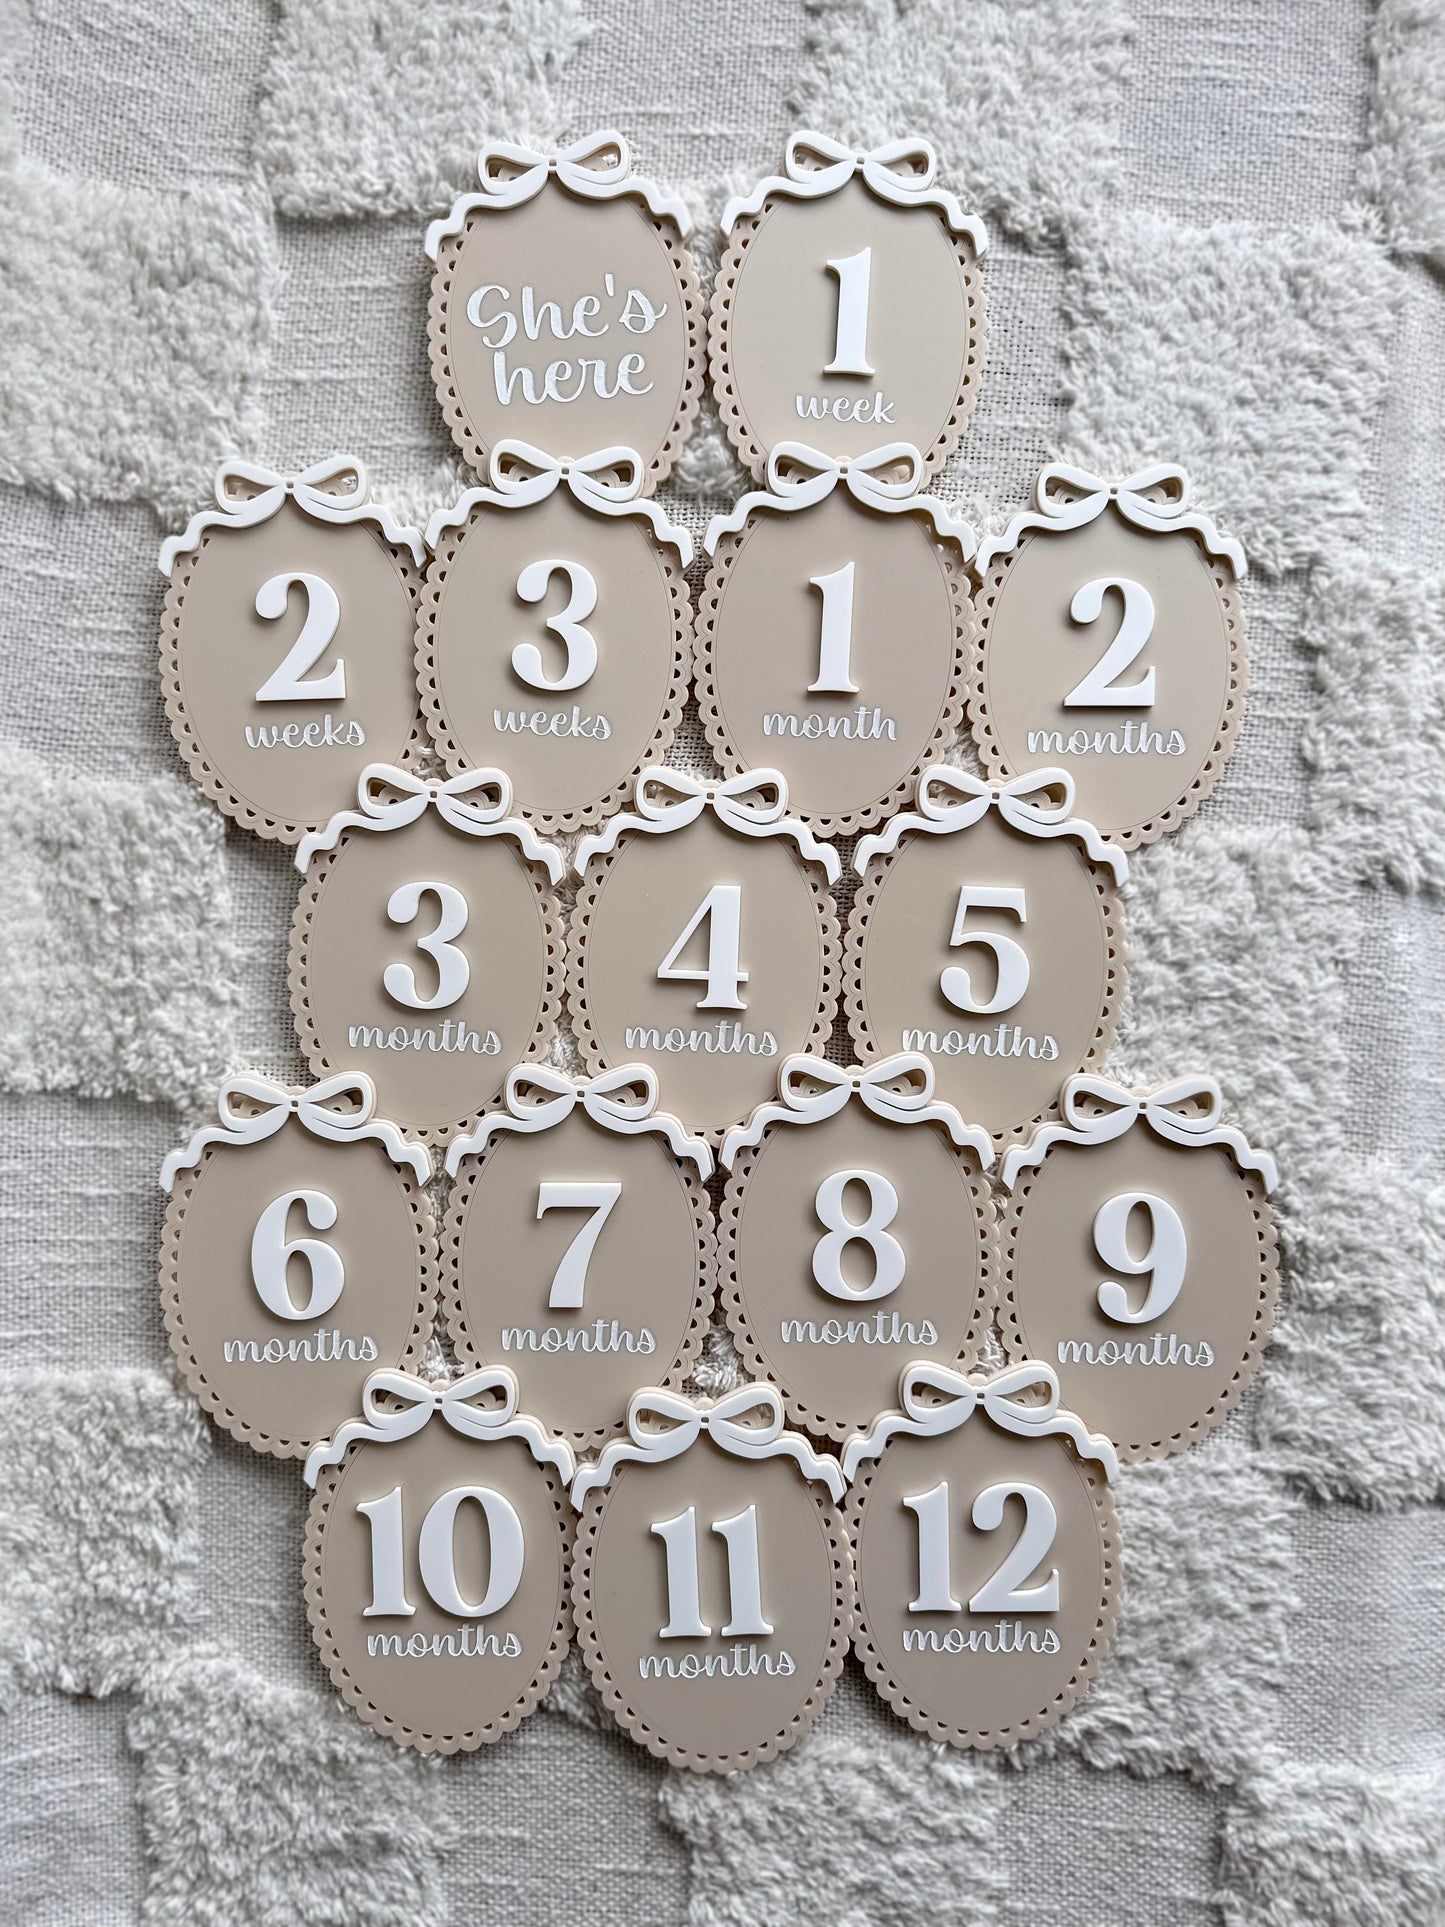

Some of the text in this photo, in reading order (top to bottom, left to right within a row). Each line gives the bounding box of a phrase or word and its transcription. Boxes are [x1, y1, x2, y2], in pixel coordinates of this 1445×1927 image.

[466, 273, 668, 348] She's
[825, 246, 876, 376] 1
[491, 350, 655, 406] here
[795, 391, 897, 425] week
[255, 571, 346, 701] 2
[512, 558, 600, 691] 3
[807, 560, 862, 693] 1
[1064, 576, 1157, 707] 2
[245, 714, 366, 748] weeks
[493, 705, 611, 740] weeks
[763, 706, 897, 741] month
[1027, 720, 1186, 756] months
[384, 881, 470, 1010] 3
[657, 884, 749, 1010] 4
[940, 885, 1031, 1014] 5
[348, 1019, 501, 1056] months
[625, 1020, 778, 1057] months
[901, 1024, 1059, 1061] months
[251, 1189, 345, 1320] 6
[536, 1181, 622, 1309] 7
[812, 1168, 906, 1301] 8
[1095, 1191, 1188, 1324] 9
[224, 1329, 378, 1363] months
[501, 1319, 655, 1354] months
[781, 1310, 938, 1346] months
[1057, 1333, 1214, 1367] months
[356, 1485, 525, 1617] 10
[650, 1504, 774, 1638] 11
[903, 1481, 1060, 1612] 12
[367, 1624, 522, 1659] months
[639, 1646, 796, 1680] months
[903, 1619, 1061, 1655] months
